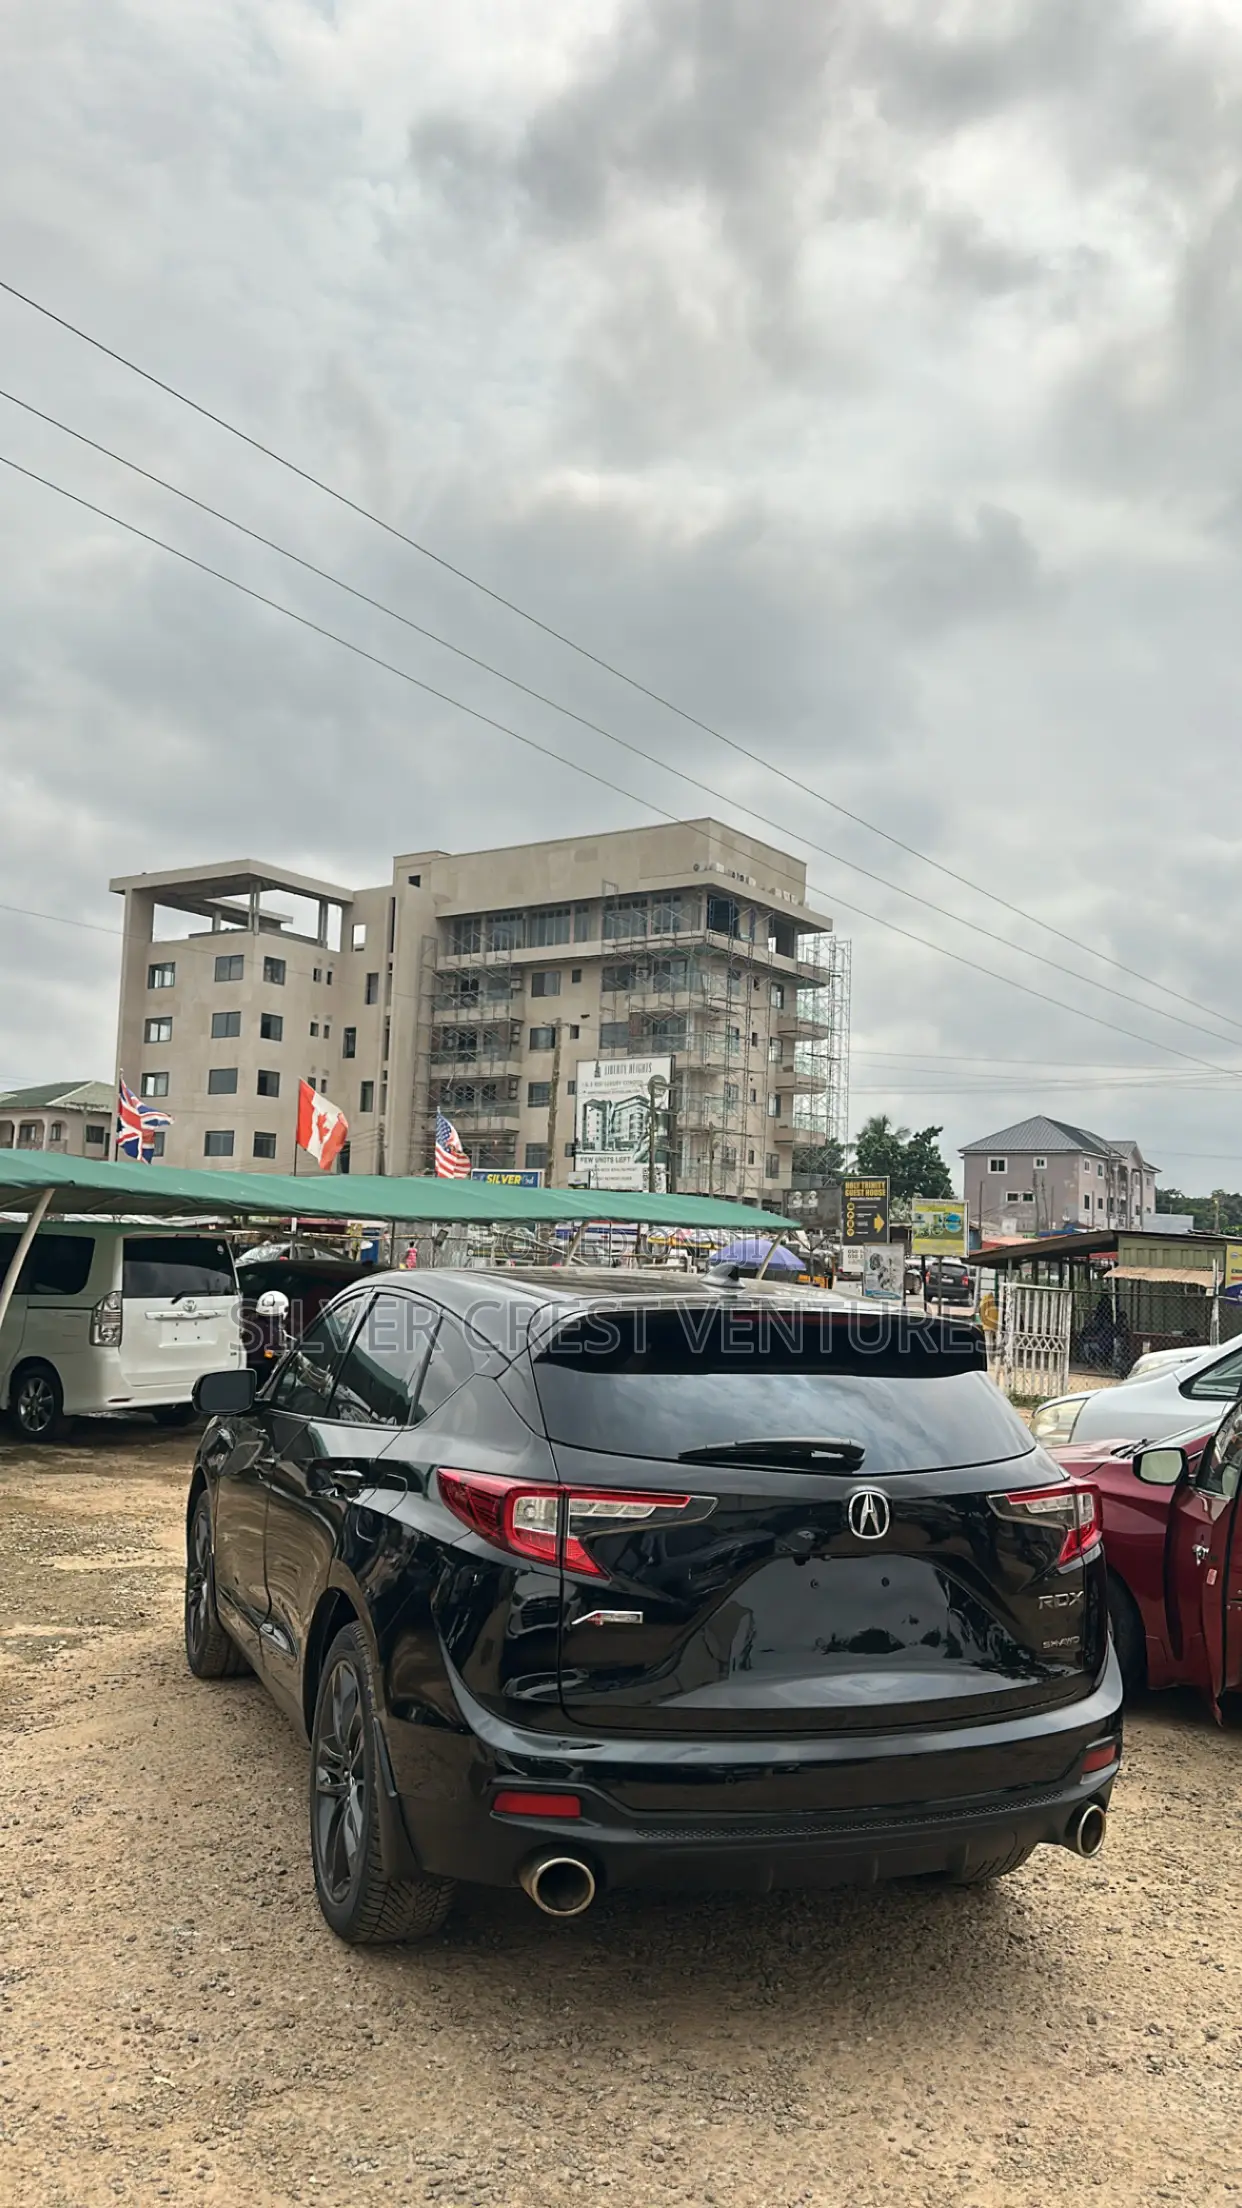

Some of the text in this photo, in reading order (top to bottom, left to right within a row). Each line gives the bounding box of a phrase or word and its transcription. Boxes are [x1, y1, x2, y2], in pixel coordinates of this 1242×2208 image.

[604, 1062, 653, 1075] LIBERTY HEIGHTS
[486, 1173, 522, 1185] SILVER
[1038, 1590, 1084, 1610] RDX
